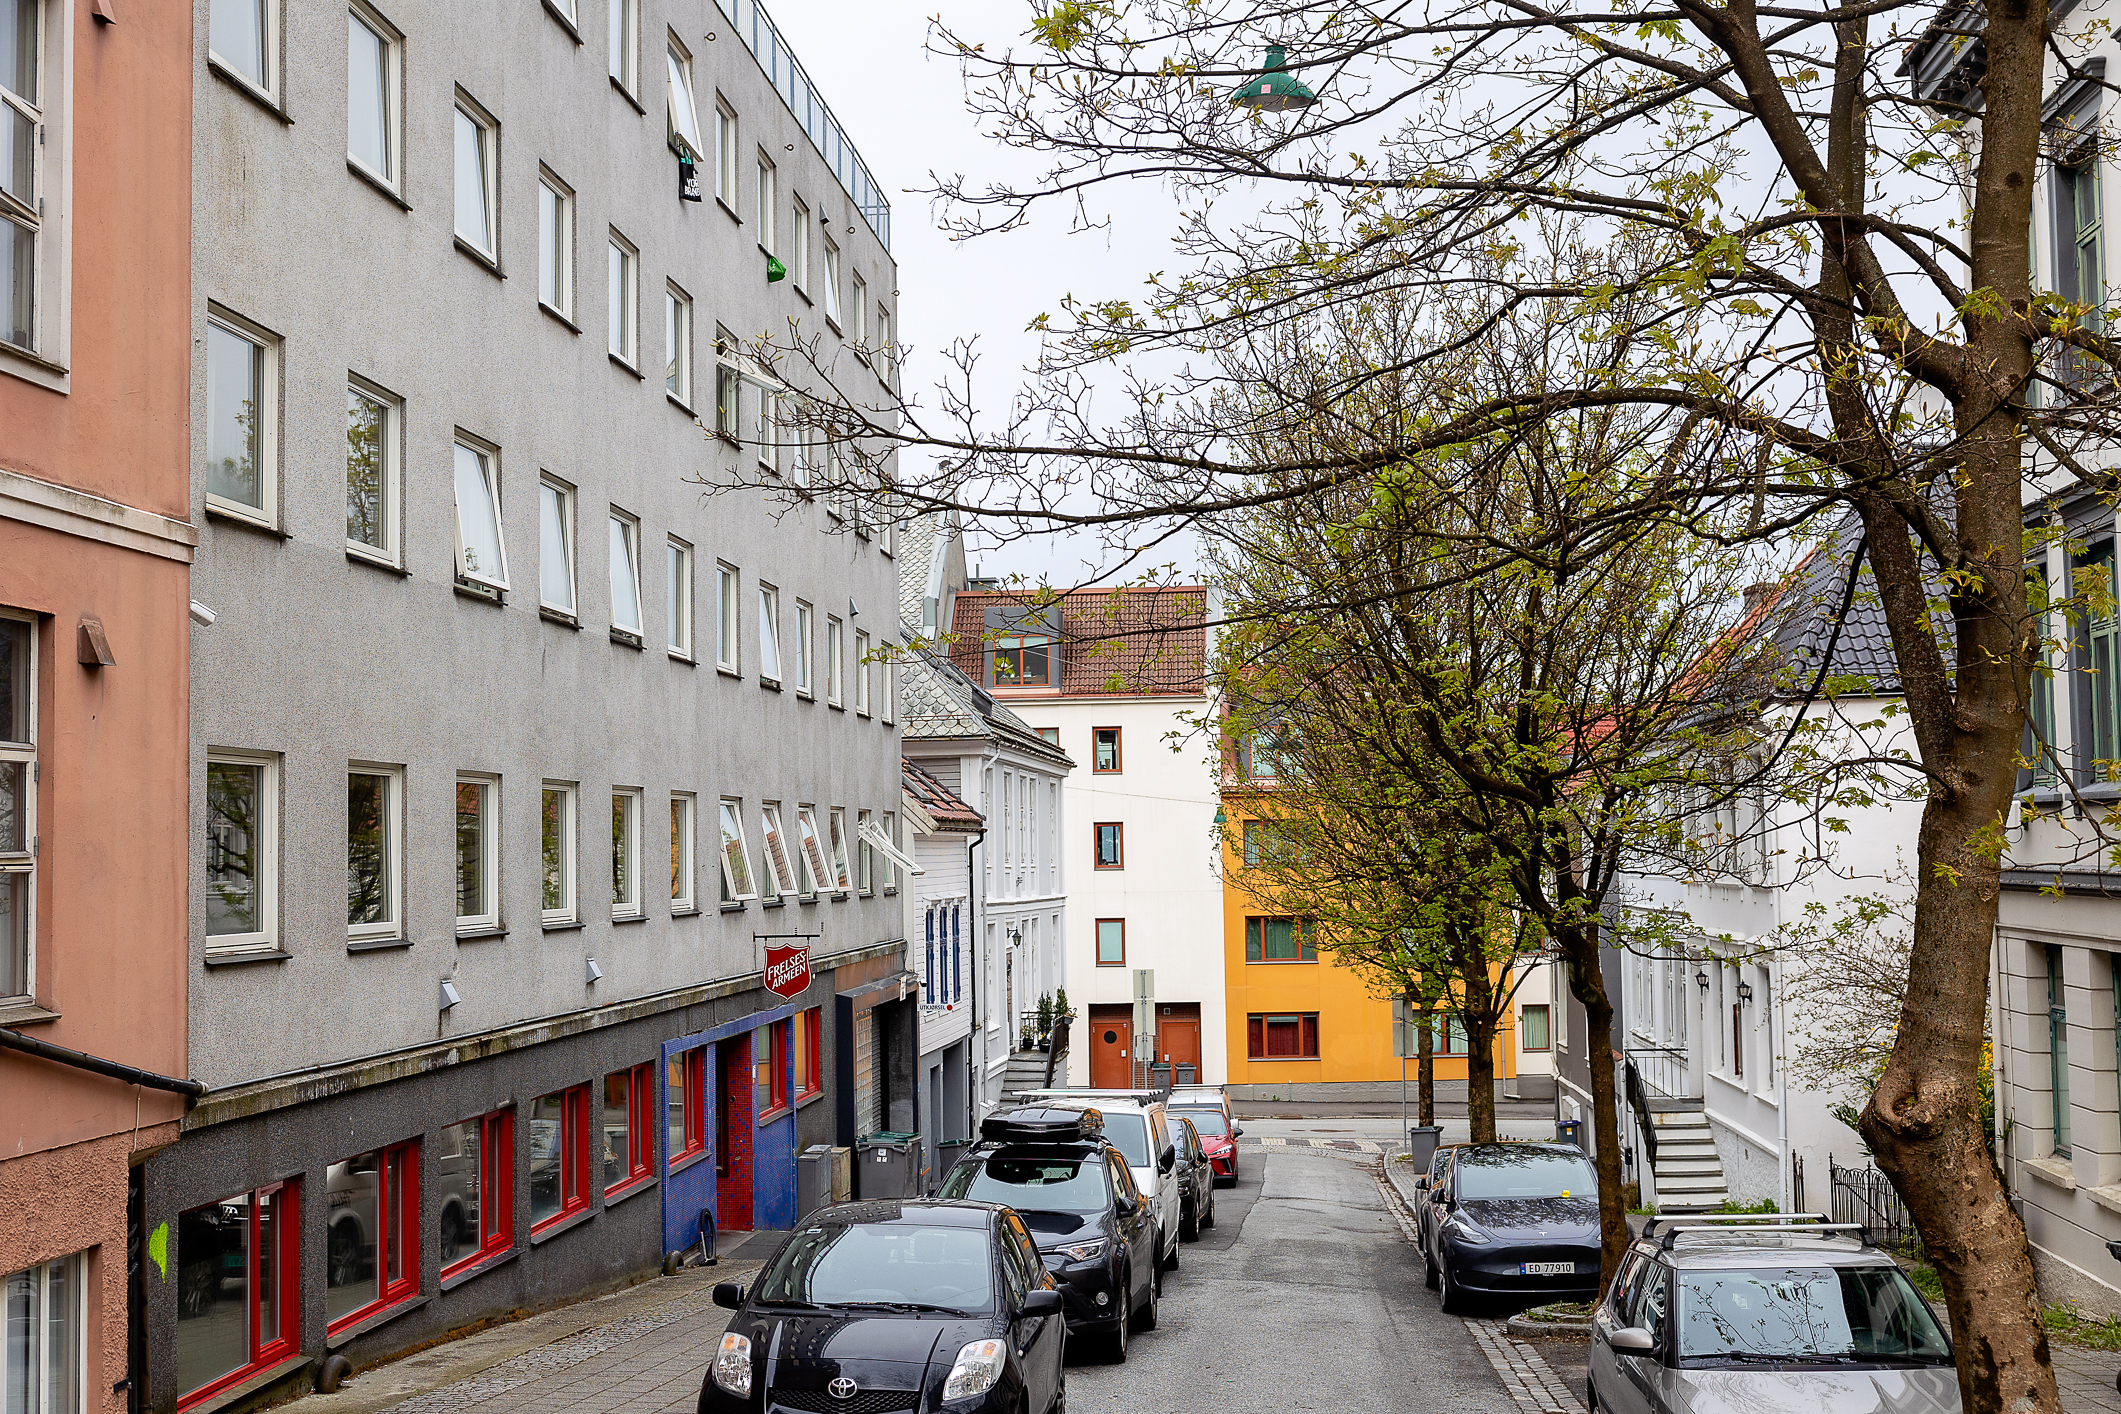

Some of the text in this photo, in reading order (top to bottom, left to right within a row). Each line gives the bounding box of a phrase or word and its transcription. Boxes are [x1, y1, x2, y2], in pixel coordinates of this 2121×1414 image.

[771, 962, 806, 990] ARMEEN
[1529, 1263, 1571, 1273] ED 77910
